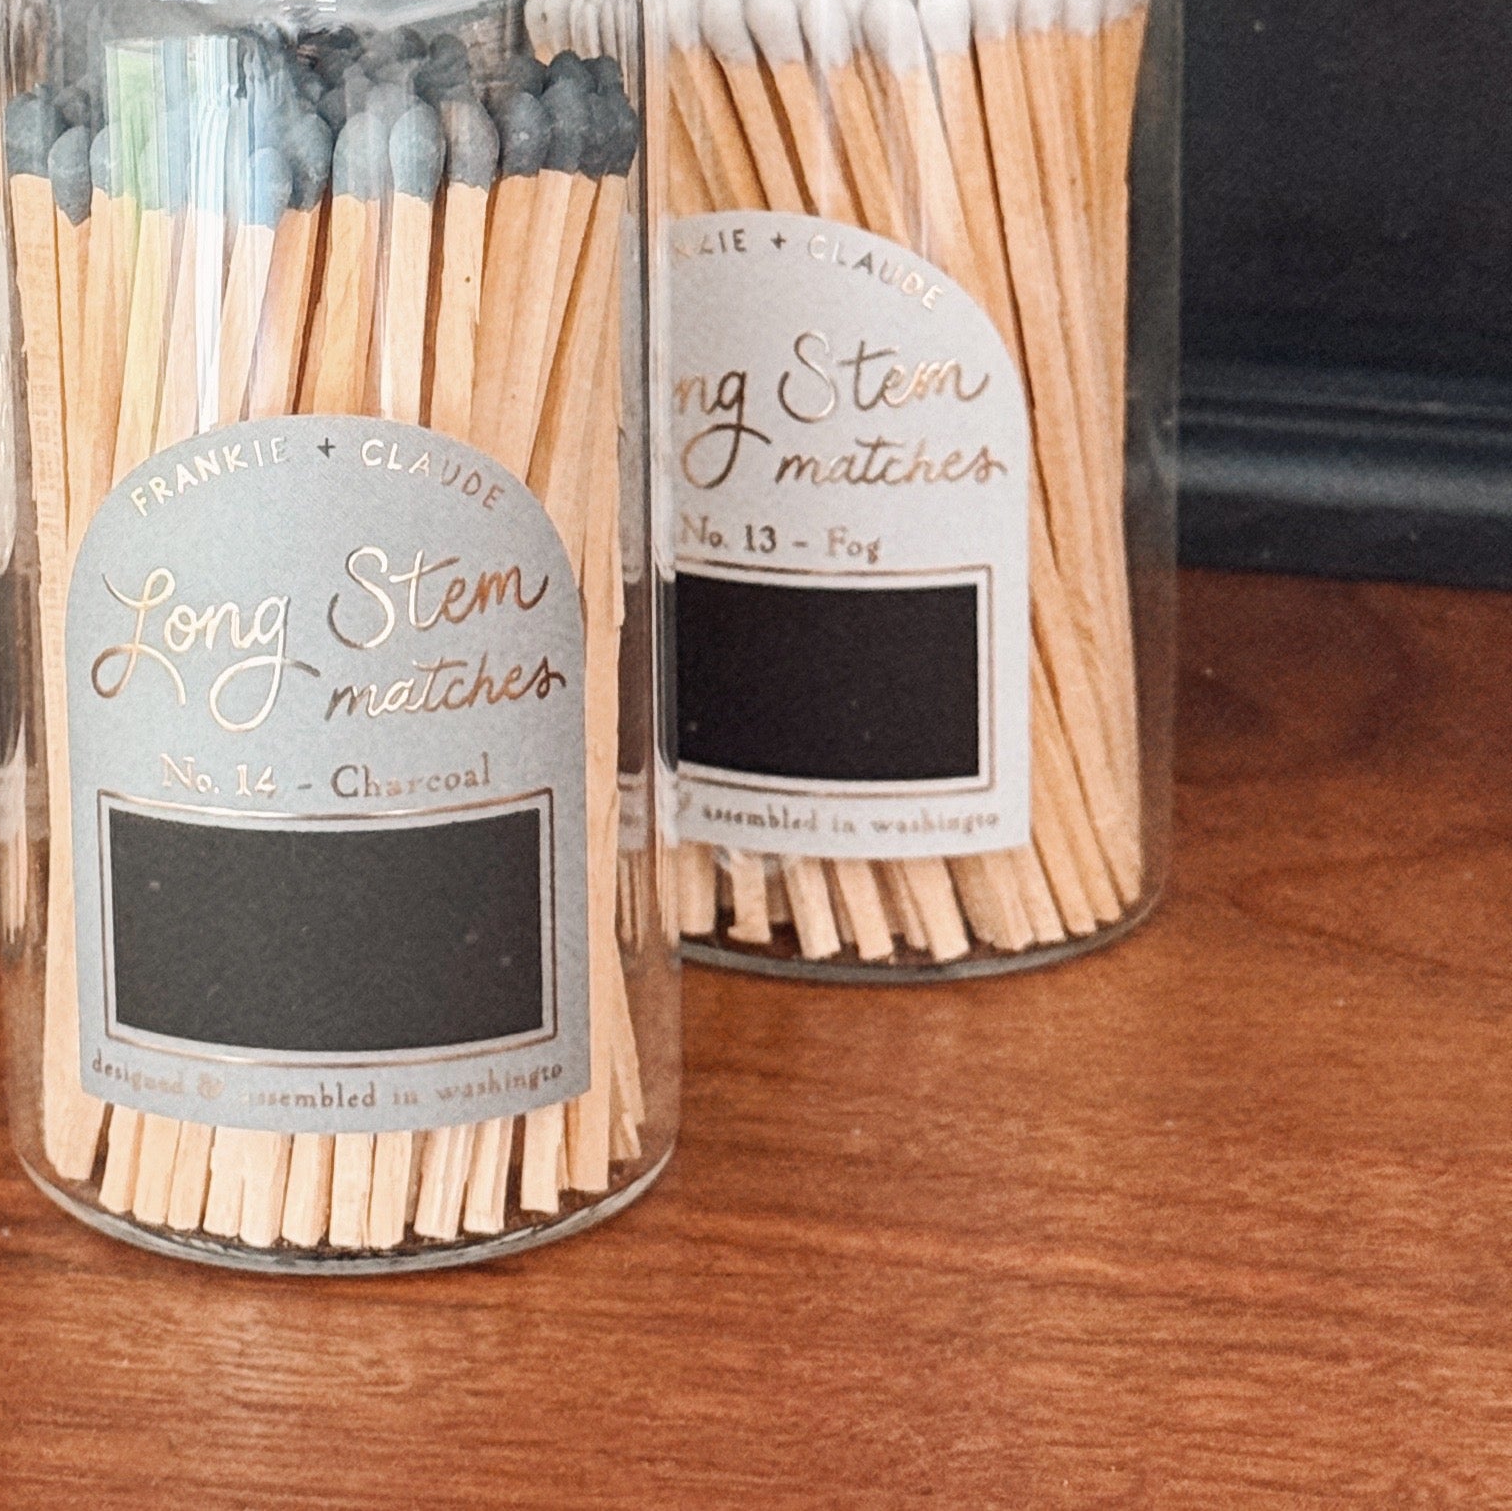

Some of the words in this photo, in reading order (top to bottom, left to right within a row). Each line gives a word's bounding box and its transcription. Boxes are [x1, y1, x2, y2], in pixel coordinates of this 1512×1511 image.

[807, 234, 946, 311] CLAUDE
[777, 329, 991, 424] Stem
[130, 436, 290, 517] FRANKIE
[359, 439, 506, 511] CLAUDE
[774, 437, 1009, 485] matches
[744, 523, 778, 554] 13
[826, 526, 884, 565] Fog
[91, 566, 321, 733] Long
[327, 545, 549, 650] Stem
[324, 655, 568, 722] matches
[160, 753, 221, 794] No.
[234, 763, 278, 800] 14
[330, 751, 492, 800] Charcoal
[90, 1047, 184, 1095] designed
[244, 1080, 377, 1109] ssembled
[393, 1086, 418, 1105] in
